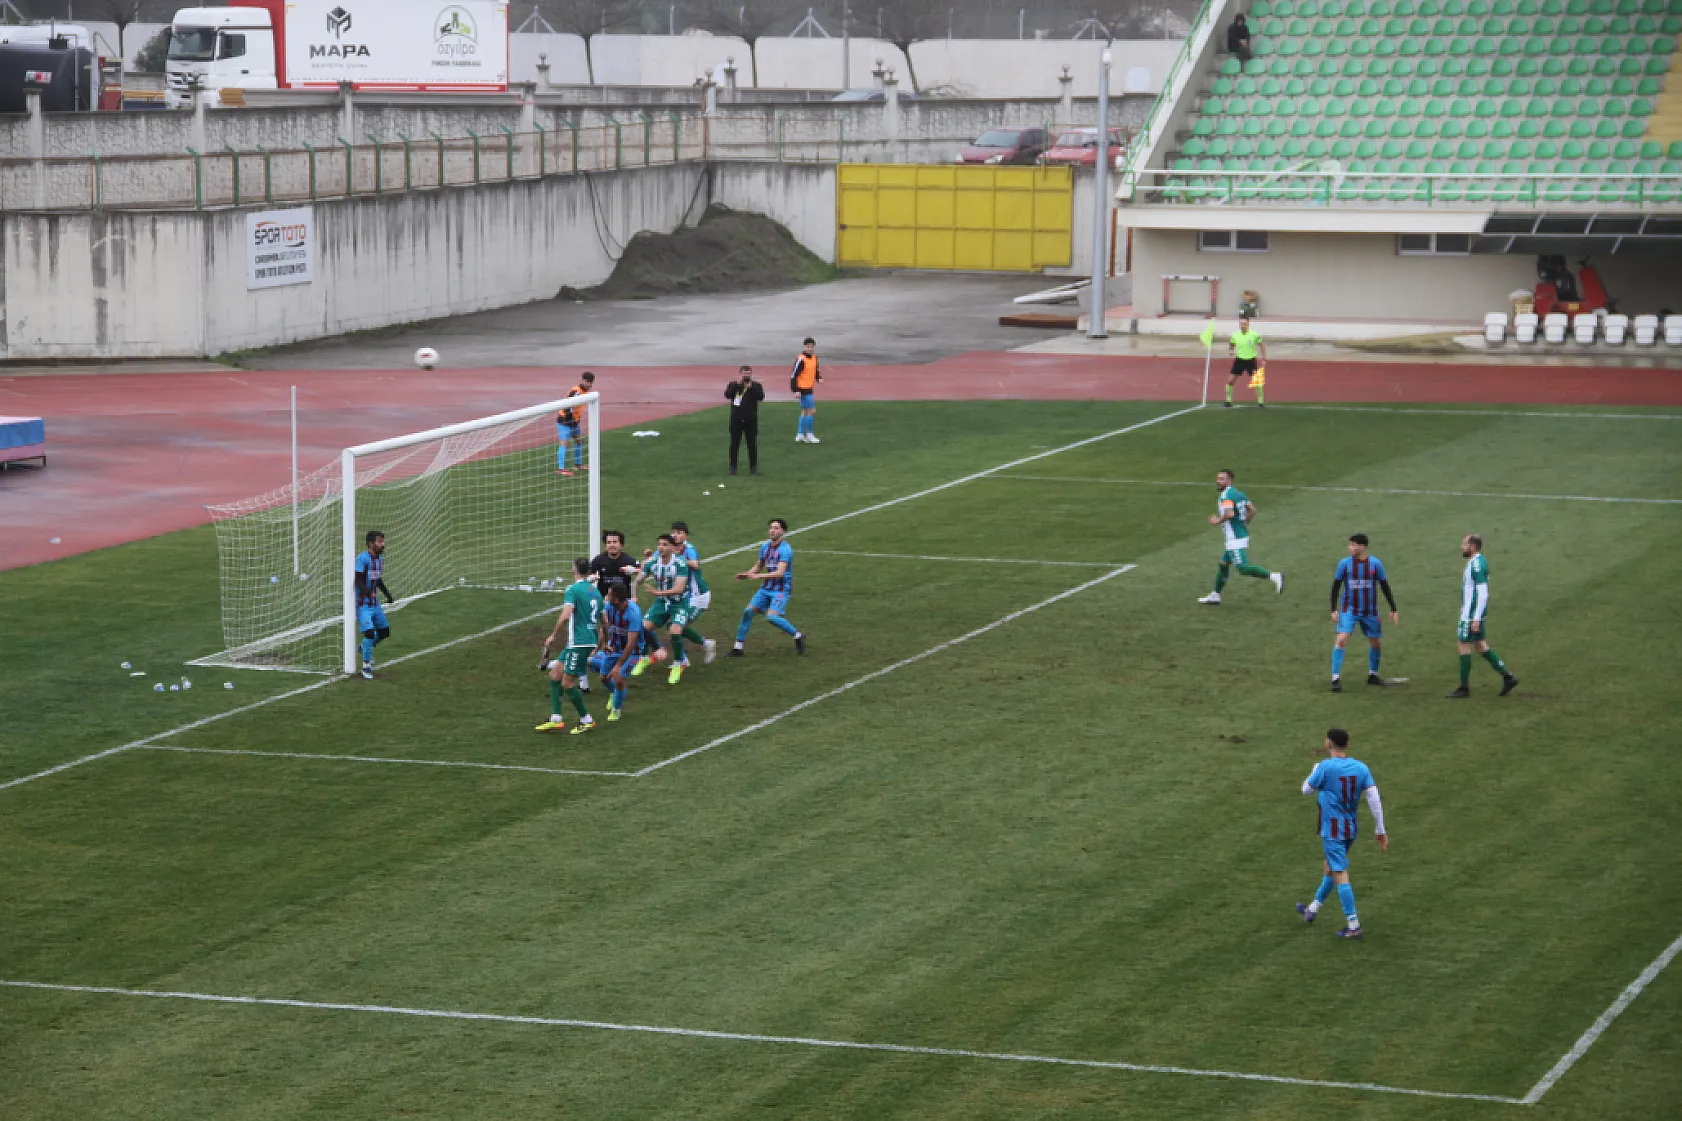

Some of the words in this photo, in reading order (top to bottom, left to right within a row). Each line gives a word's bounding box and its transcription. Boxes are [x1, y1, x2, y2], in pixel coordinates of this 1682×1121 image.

[308, 44, 371, 59] MAPA
[589, 599, 599, 623] 2
[1339, 776, 1357, 805] 11
